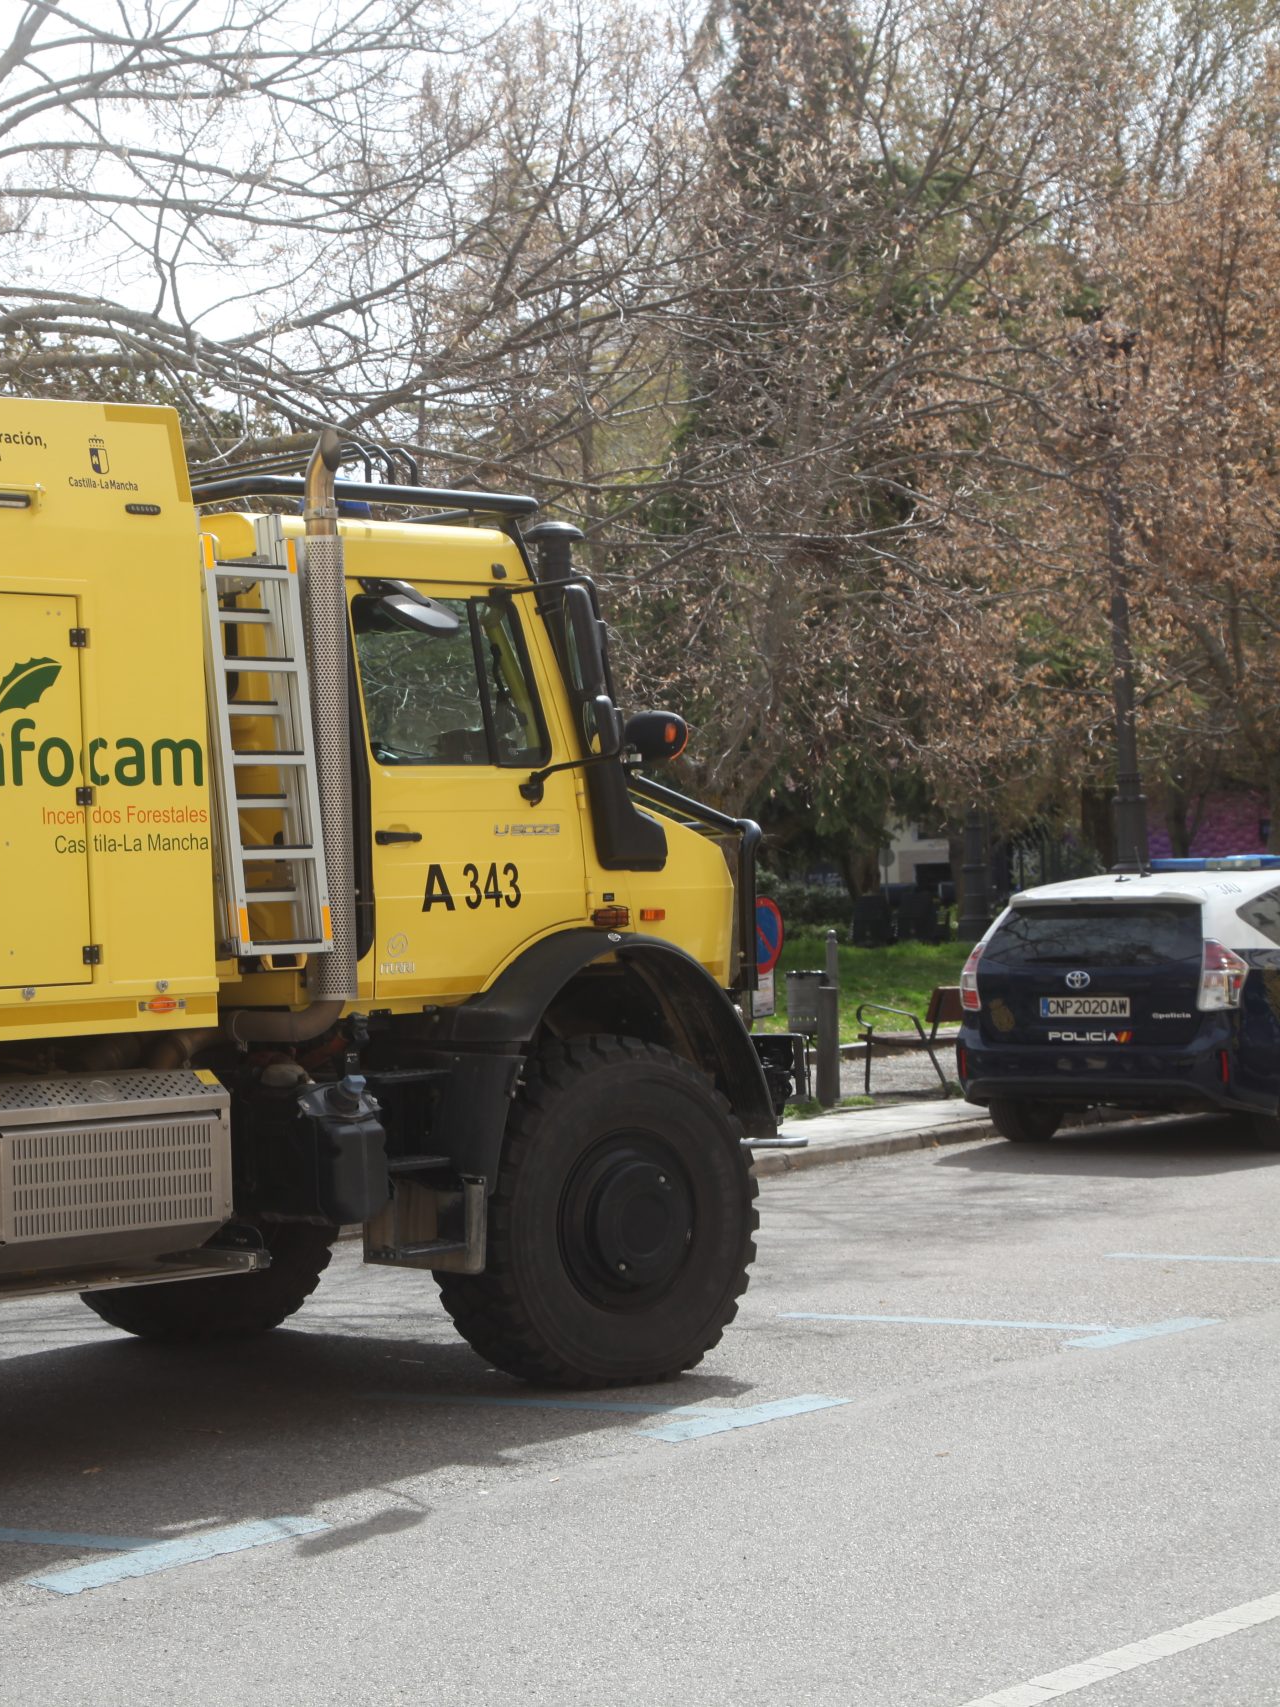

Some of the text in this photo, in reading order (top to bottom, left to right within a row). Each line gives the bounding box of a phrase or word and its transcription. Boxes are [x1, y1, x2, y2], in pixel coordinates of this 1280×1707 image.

[109, 479, 139, 491] Mancha
[126, 805, 208, 824] Forestales
[147, 832, 209, 851] Mancha
[421, 862, 521, 912] A 343
[1048, 1030, 1119, 1042] POLICÍA
